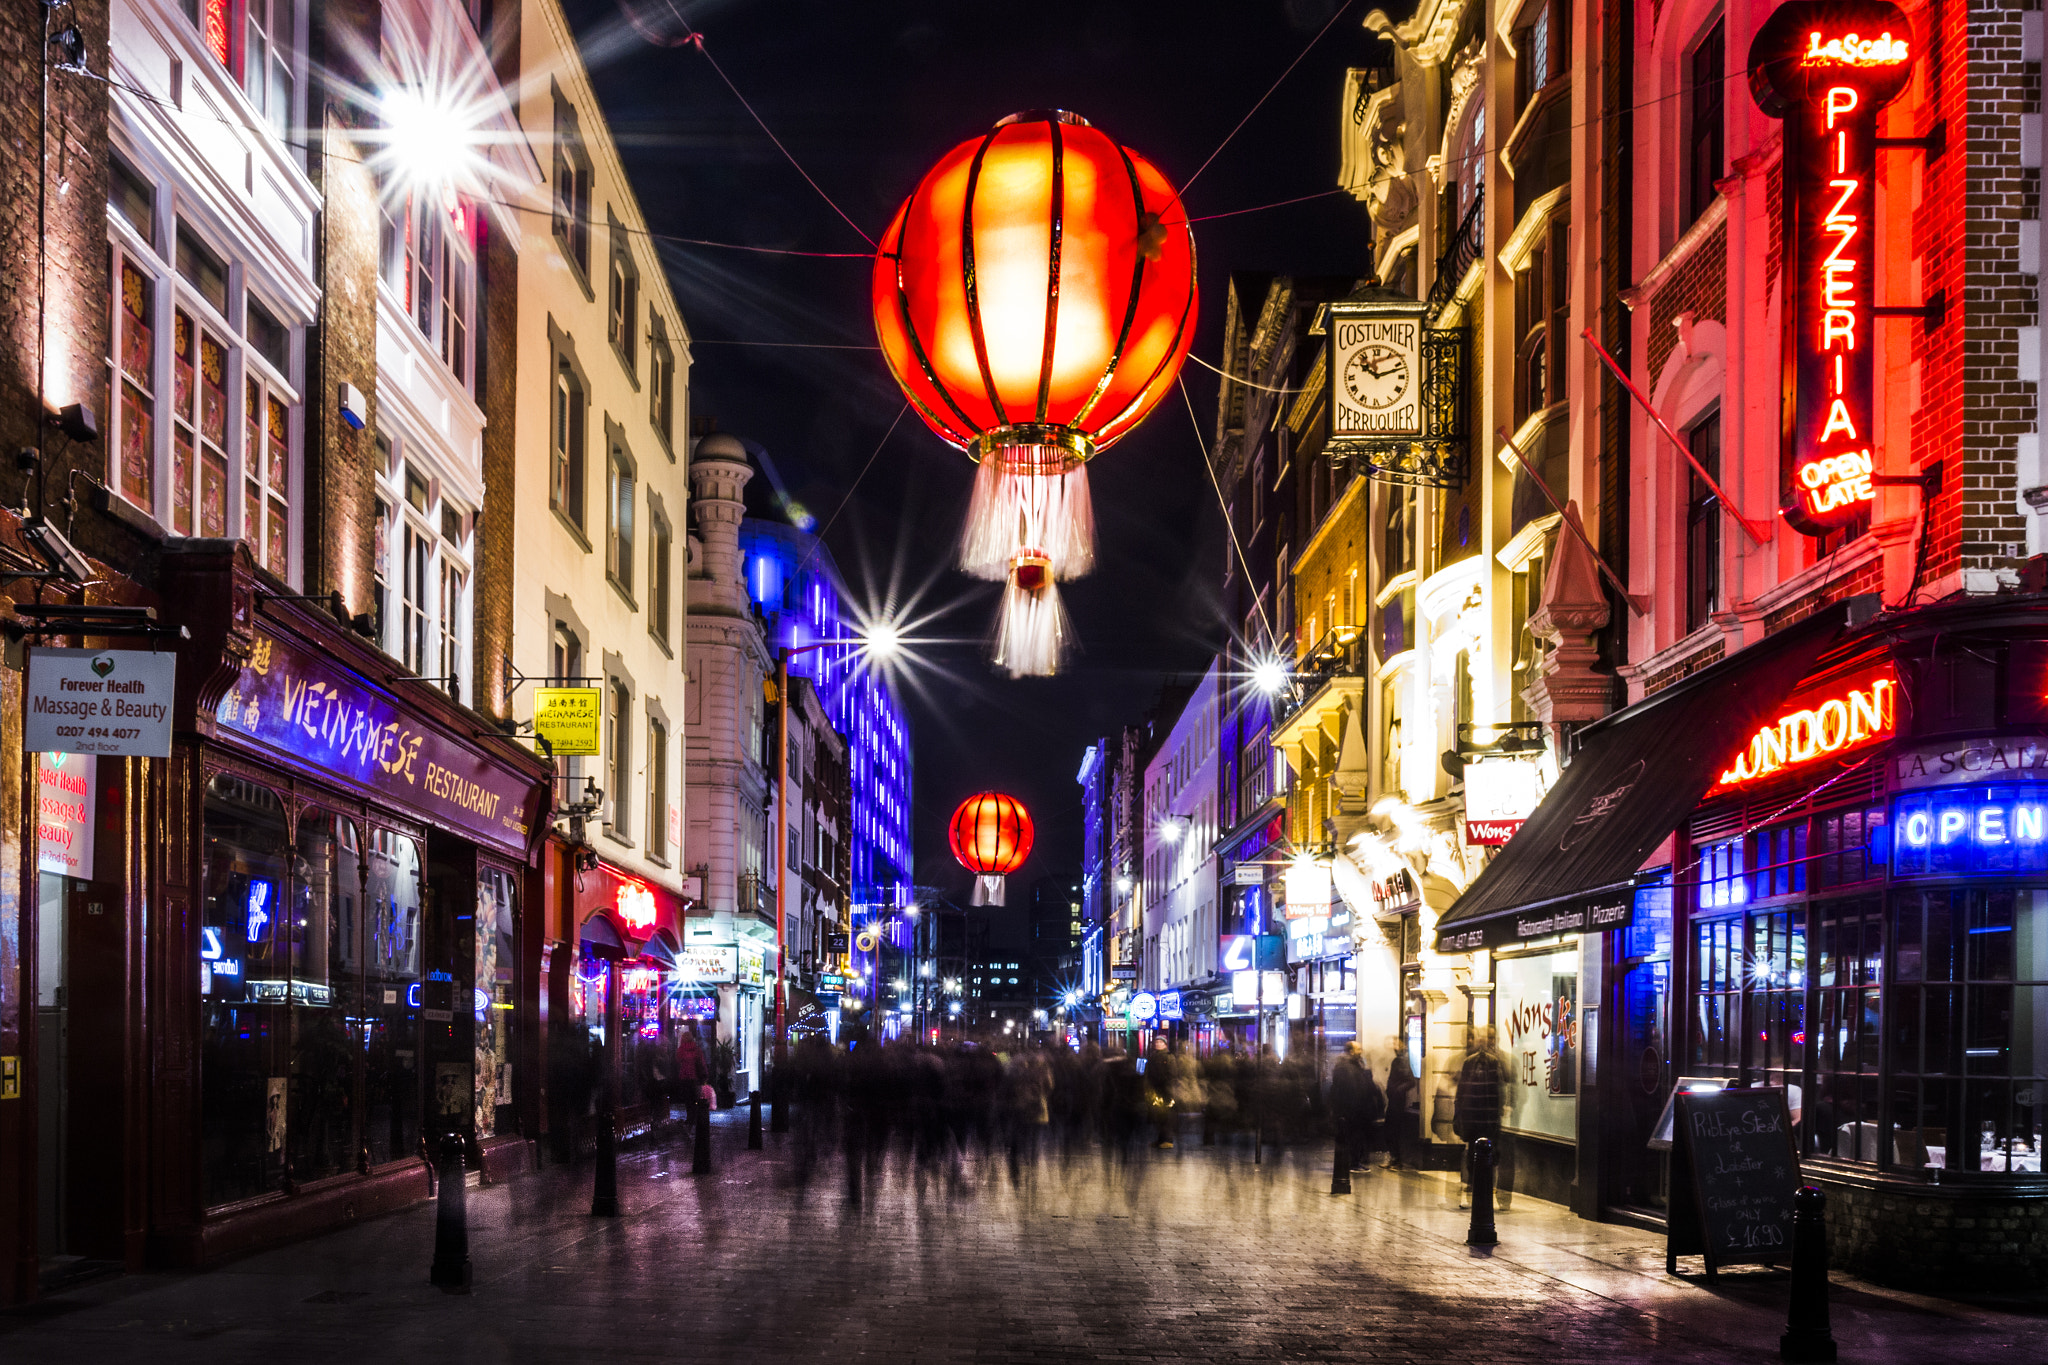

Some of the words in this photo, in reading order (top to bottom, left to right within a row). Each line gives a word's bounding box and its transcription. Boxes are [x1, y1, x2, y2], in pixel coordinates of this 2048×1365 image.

[1821, 86, 1859, 443] PIZZERIA
[1338, 323, 1415, 352] COSTUMIER
[1338, 402, 1415, 432] PERRUQUIER
[1801, 448, 1873, 489] OPEN
[1811, 474, 1877, 513] LATE
[60, 678, 104, 692] Forever
[107, 679, 145, 694] Health
[33, 695, 98, 720] Massage
[101, 698, 112, 717] &
[115, 699, 167, 723] Beauty
[539, 709, 594, 718] VIETNAMESE
[56, 726, 85, 737] 0207
[88, 727, 109, 738] 494
[112, 728, 141, 740] 4077
[282, 674, 424, 785] VIETNAMESE
[539, 721, 593, 729] RESTAURANT
[75, 741, 95, 751] 2nd
[97, 741, 120, 751] floor
[575, 739, 593, 747] 2592
[1895, 753, 1929, 780] LA
[60, 770, 87, 797] Health
[424, 762, 500, 820] RESTAURANT
[77, 803, 86, 824] &
[1906, 807, 2043, 845] OPEN
[1469, 823, 1512, 843] Wong
[62, 853, 78, 867] Floor
[90, 903, 102, 914] 34
[1553, 911, 1584, 931] Italiano
[1592, 901, 1626, 925] Pizzeria
[833, 938, 844, 947] 22
[1504, 996, 1552, 1048] Wong
[1714, 1153, 1764, 1174] Lobster
